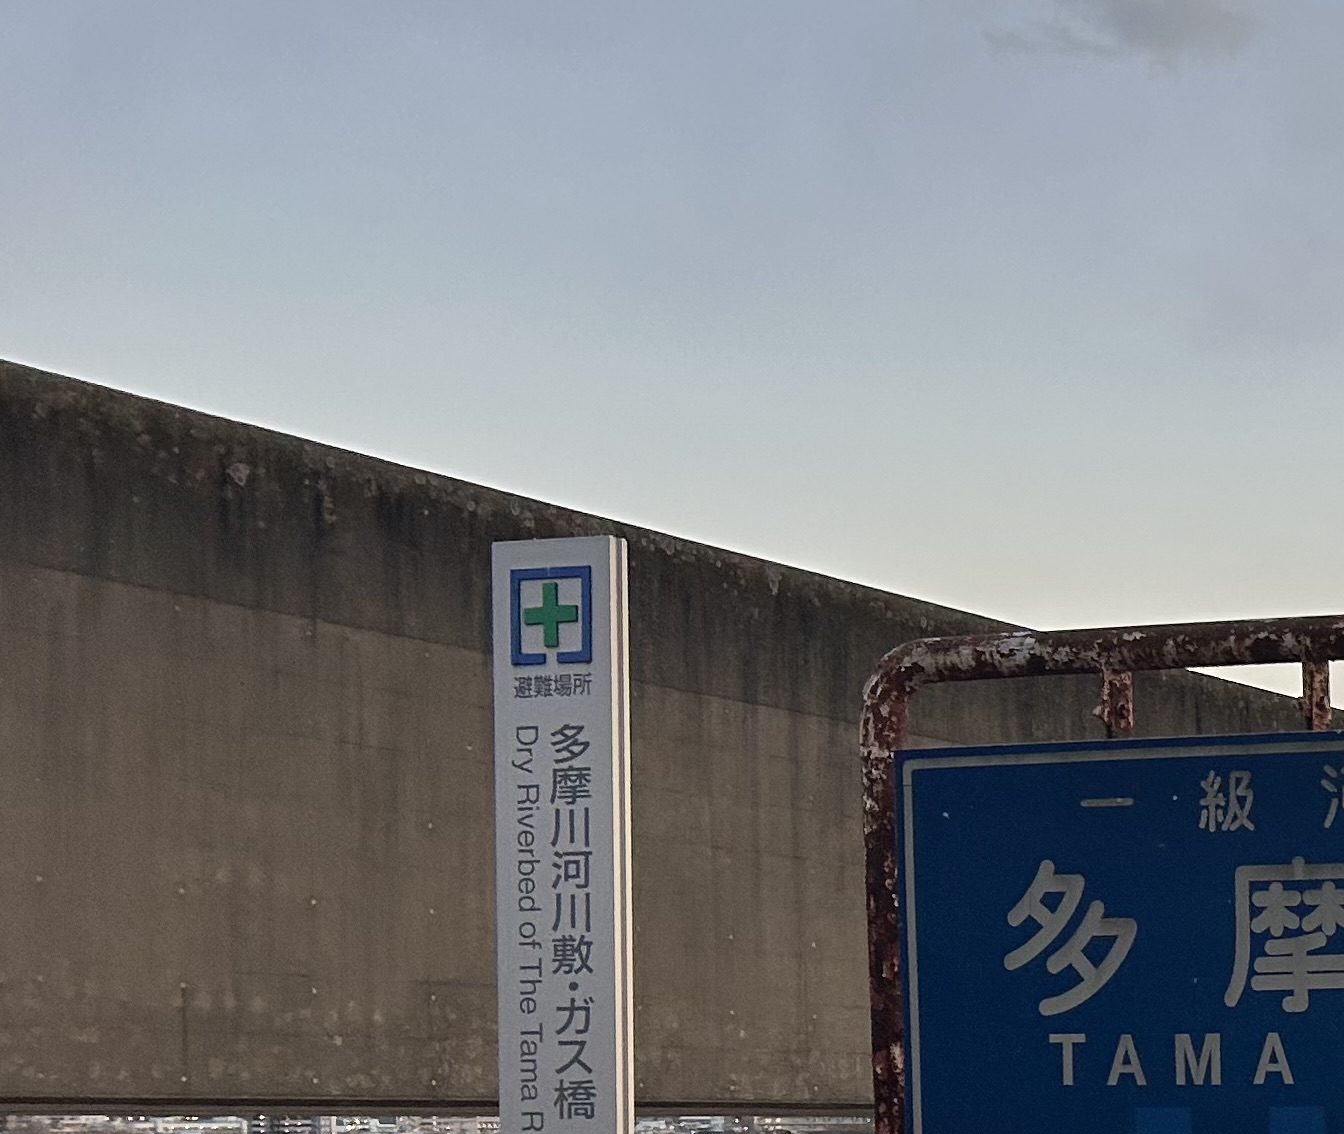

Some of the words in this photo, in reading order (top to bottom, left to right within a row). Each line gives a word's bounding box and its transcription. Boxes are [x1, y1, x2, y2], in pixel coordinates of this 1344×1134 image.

[514, 672, 592, 699] 避難場所
[512, 725, 539, 774] Dry
[517, 784, 542, 911] Riverbed
[518, 921, 541, 949] of
[519, 958, 543, 1014] The
[520, 1023, 543, 1102] Tama
[1048, 1032, 1295, 1087] TAMA
